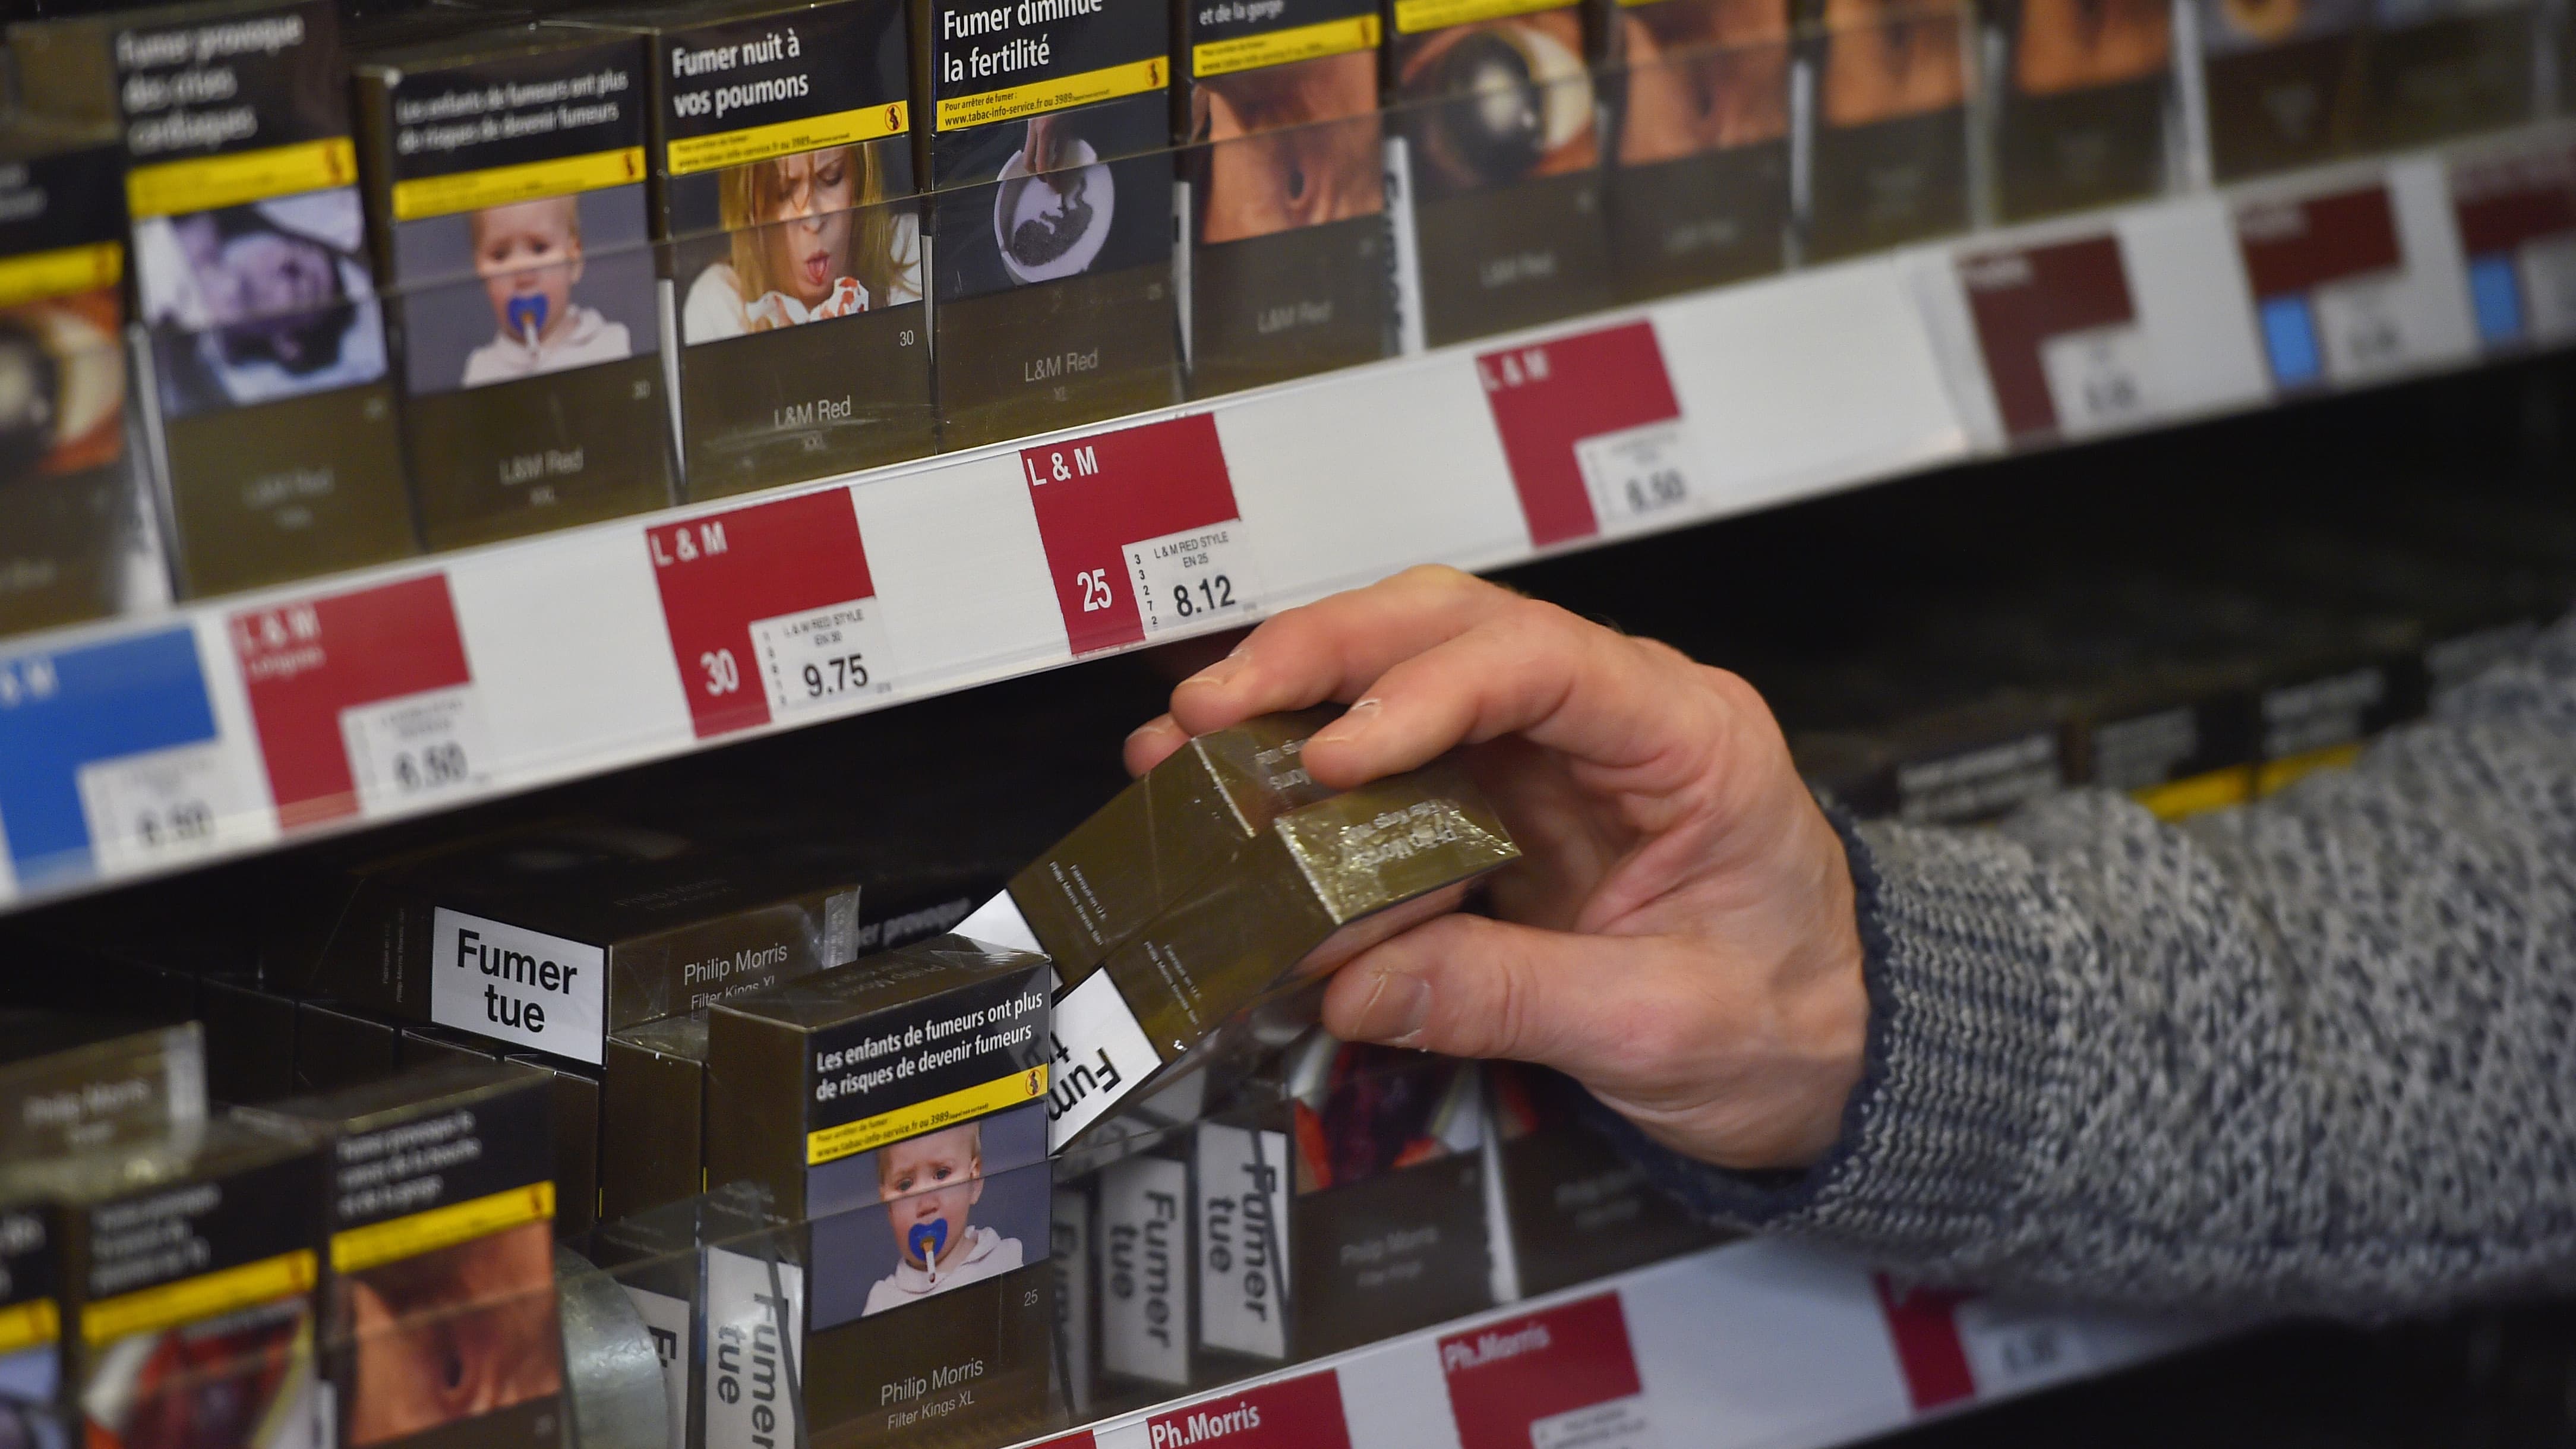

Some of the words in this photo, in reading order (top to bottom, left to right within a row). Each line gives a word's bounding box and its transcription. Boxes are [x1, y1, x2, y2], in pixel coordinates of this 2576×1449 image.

[944, 5, 1011, 40] Fumer
[1018, 0, 1103, 26] diminue
[673, 46, 737, 78] Fumer
[743, 33, 783, 65] nuit
[788, 28, 800, 58] à
[944, 52, 964, 83] la
[970, 34, 1050, 78] fertilité
[674, 89, 711, 118] vos
[716, 74, 809, 119] poumons
[945, 102, 959, 112] Pour
[962, 97, 984, 109] arrêter
[995, 93, 1012, 103] fumer
[945, 98, 1042, 127] www.tabac-info-service.fr
[1044, 98, 1053, 107] ou
[1055, 93, 1072, 105] 3989
[899, 330, 914, 346] 30
[1025, 354, 1060, 383] L&M
[1067, 349, 1098, 374] Red
[774, 402, 813, 428] L&M
[817, 394, 851, 421] Red
[500, 454, 544, 484] L&M
[545, 447, 583, 474] Red
[1027, 457, 1047, 486] L
[1052, 452, 1071, 481] &
[1074, 446, 1098, 476] M
[653, 534, 673, 566] L
[676, 527, 697, 561] &
[700, 521, 727, 556] M
[1154, 548, 1160, 558] L
[1162, 547, 1169, 557] &
[1169, 543, 1178, 555] M
[1179, 539, 1198, 553] RED
[1200, 531, 1229, 548] STYLE
[1183, 557, 1197, 568] EN
[1197, 553, 1209, 564] 25
[1077, 568, 1112, 612] 25
[1173, 574, 1236, 617] 8.12
[700, 648, 740, 695] 30
[803, 654, 868, 698] 9.75
[458, 928, 577, 995] Fumer
[684, 957, 730, 986] Philip
[736, 942, 788, 973] Morris
[484, 984, 545, 1033] tue
[692, 992, 722, 1010] Filter
[817, 1050, 843, 1073] Les
[845, 1033, 902, 1064] enfants
[904, 1025, 923, 1045] de
[925, 1009, 984, 1040] fumeurs
[988, 1000, 1011, 1022] ont
[1015, 991, 1043, 1020] plus
[816, 1078, 838, 1101] de
[840, 1066, 893, 1095] risques
[896, 1058, 914, 1079] de
[918, 1040, 972, 1072] devenir
[975, 1024, 1032, 1056] fumeurs
[1048, 1047, 1122, 1121] Fum
[920, 1119, 928, 1128] ou
[930, 1111, 949, 1125] 3989
[1208, 1197, 1236, 1274] tue
[1242, 1163, 1276, 1322] Fumer
[1110, 1224, 1138, 1299] tue
[1145, 1190, 1176, 1349] Fumer
[1024, 1289, 1038, 1307] 25
[718, 1325, 746, 1404] tue
[752, 1293, 789, 1449] Fumer
[882, 1377, 927, 1406] Philip
[932, 1358, 983, 1390] Morris
[888, 1410, 918, 1430] Filter
[922, 1398, 955, 1419] Kings
[959, 1390, 975, 1407] XL
[1151, 1401, 1261, 1449] Ph.Morris
